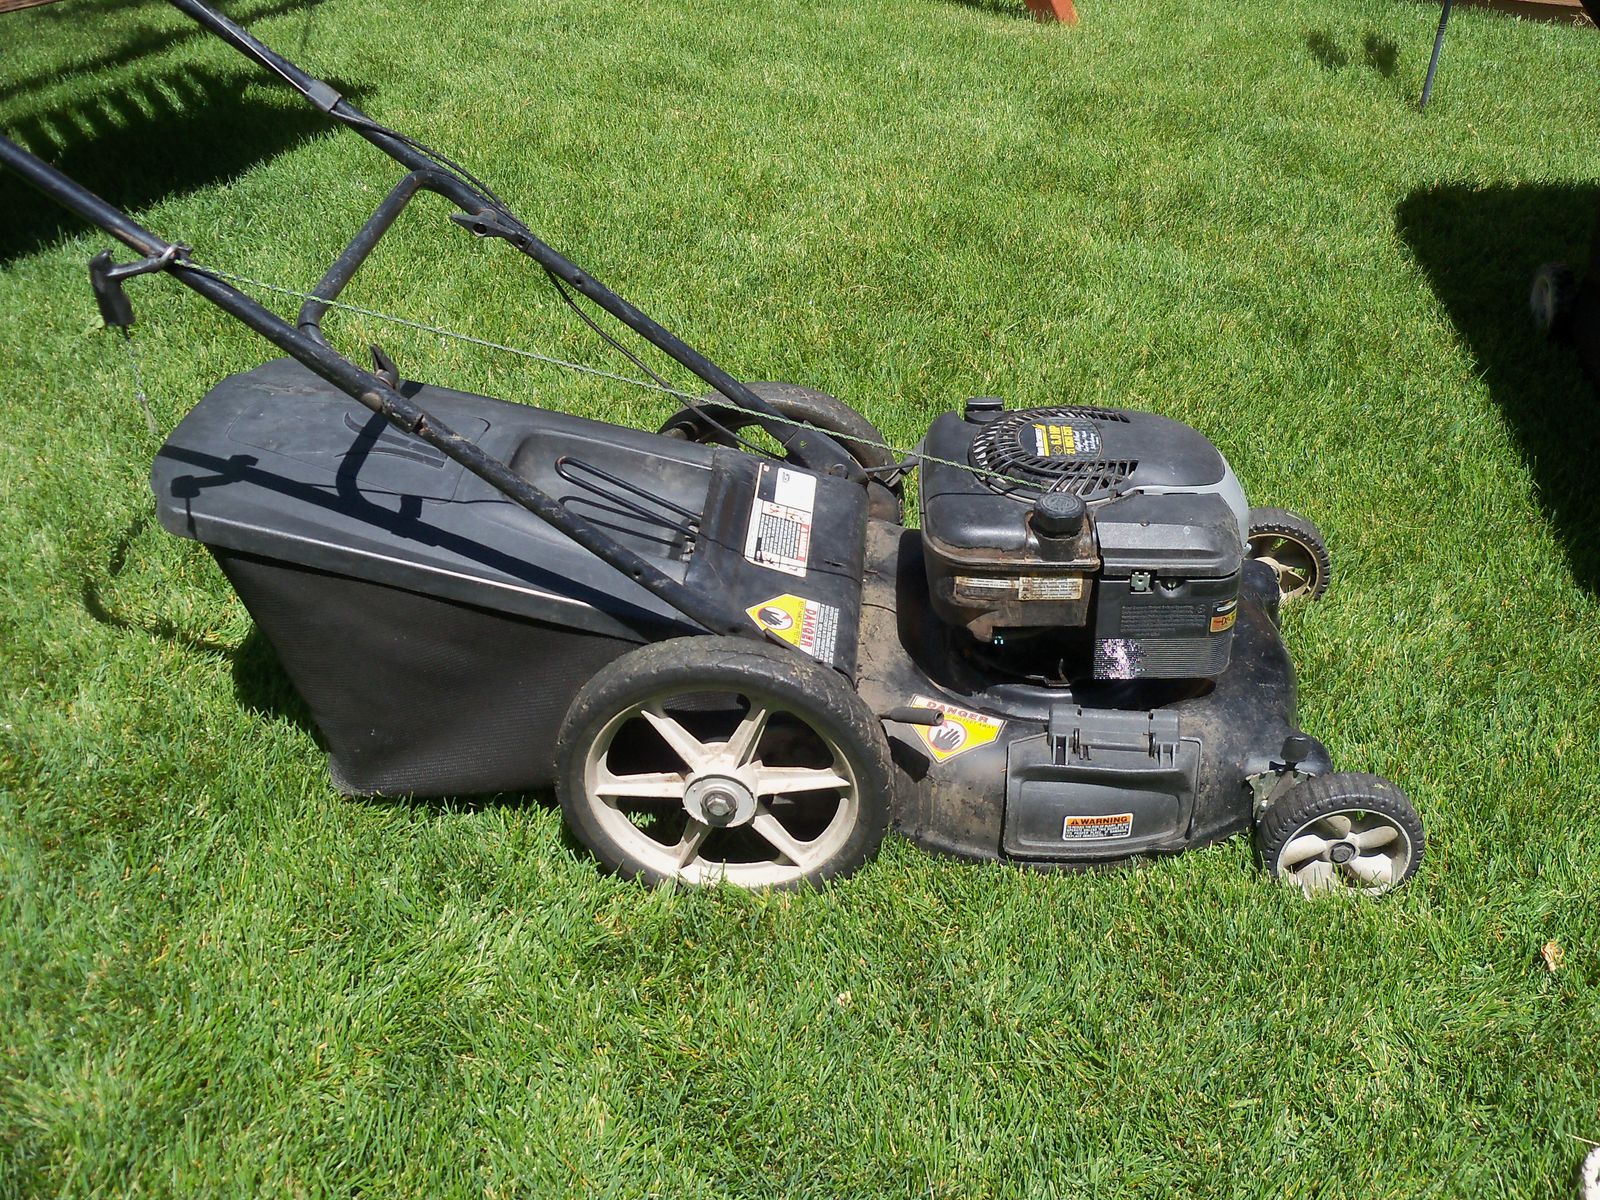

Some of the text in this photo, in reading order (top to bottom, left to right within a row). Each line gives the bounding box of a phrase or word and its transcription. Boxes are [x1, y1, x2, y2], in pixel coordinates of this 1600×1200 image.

[1049, 425, 1061, 434] HP
[801, 609, 817, 648] DANGER
[926, 701, 989, 723] DANGER
[1080, 816, 1128, 825] WARNING
